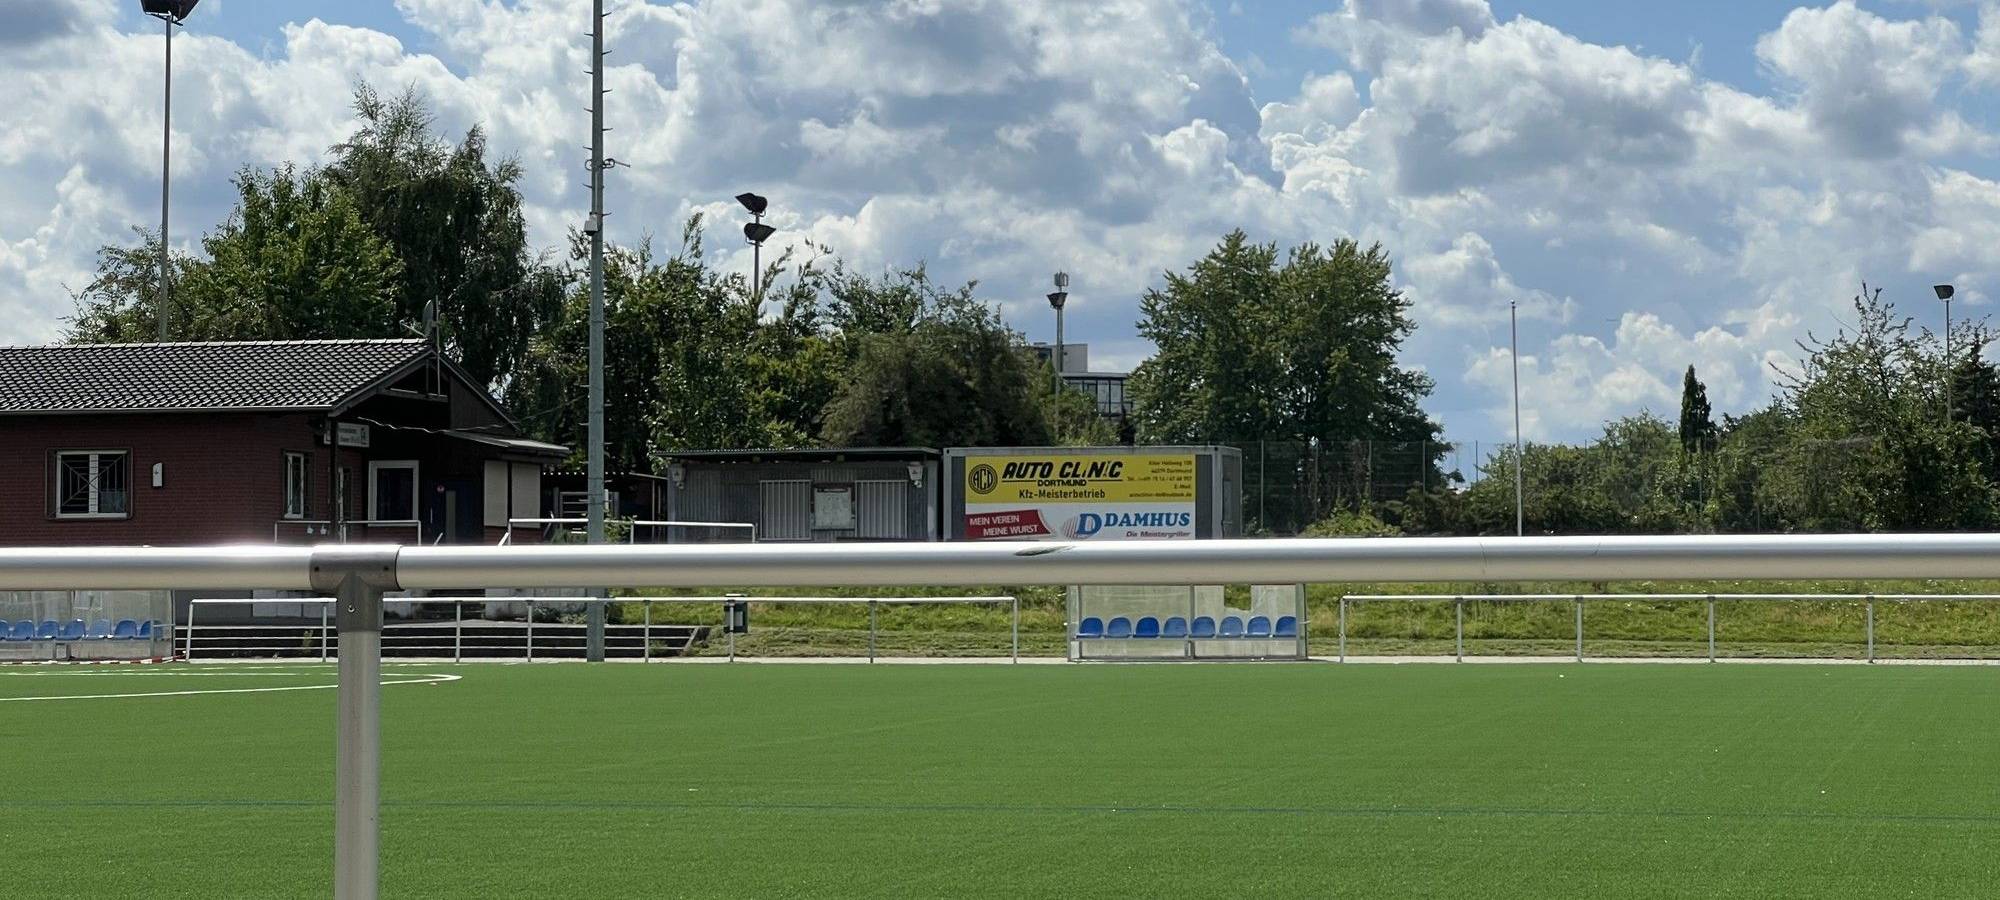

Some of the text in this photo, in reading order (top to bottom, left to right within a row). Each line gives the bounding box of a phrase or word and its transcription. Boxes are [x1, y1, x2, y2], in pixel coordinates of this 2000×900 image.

[1002, 461, 1054, 479] AUTO
[1037, 479, 1087, 487] DORTMUND
[1019, 488, 1106, 499] Kfz-Meisterbetrieb
[969, 515, 1020, 526] MEIN VEREIN
[1104, 512, 1191, 527] DAMHUS
[983, 524, 1038, 537] MEINE WURST
